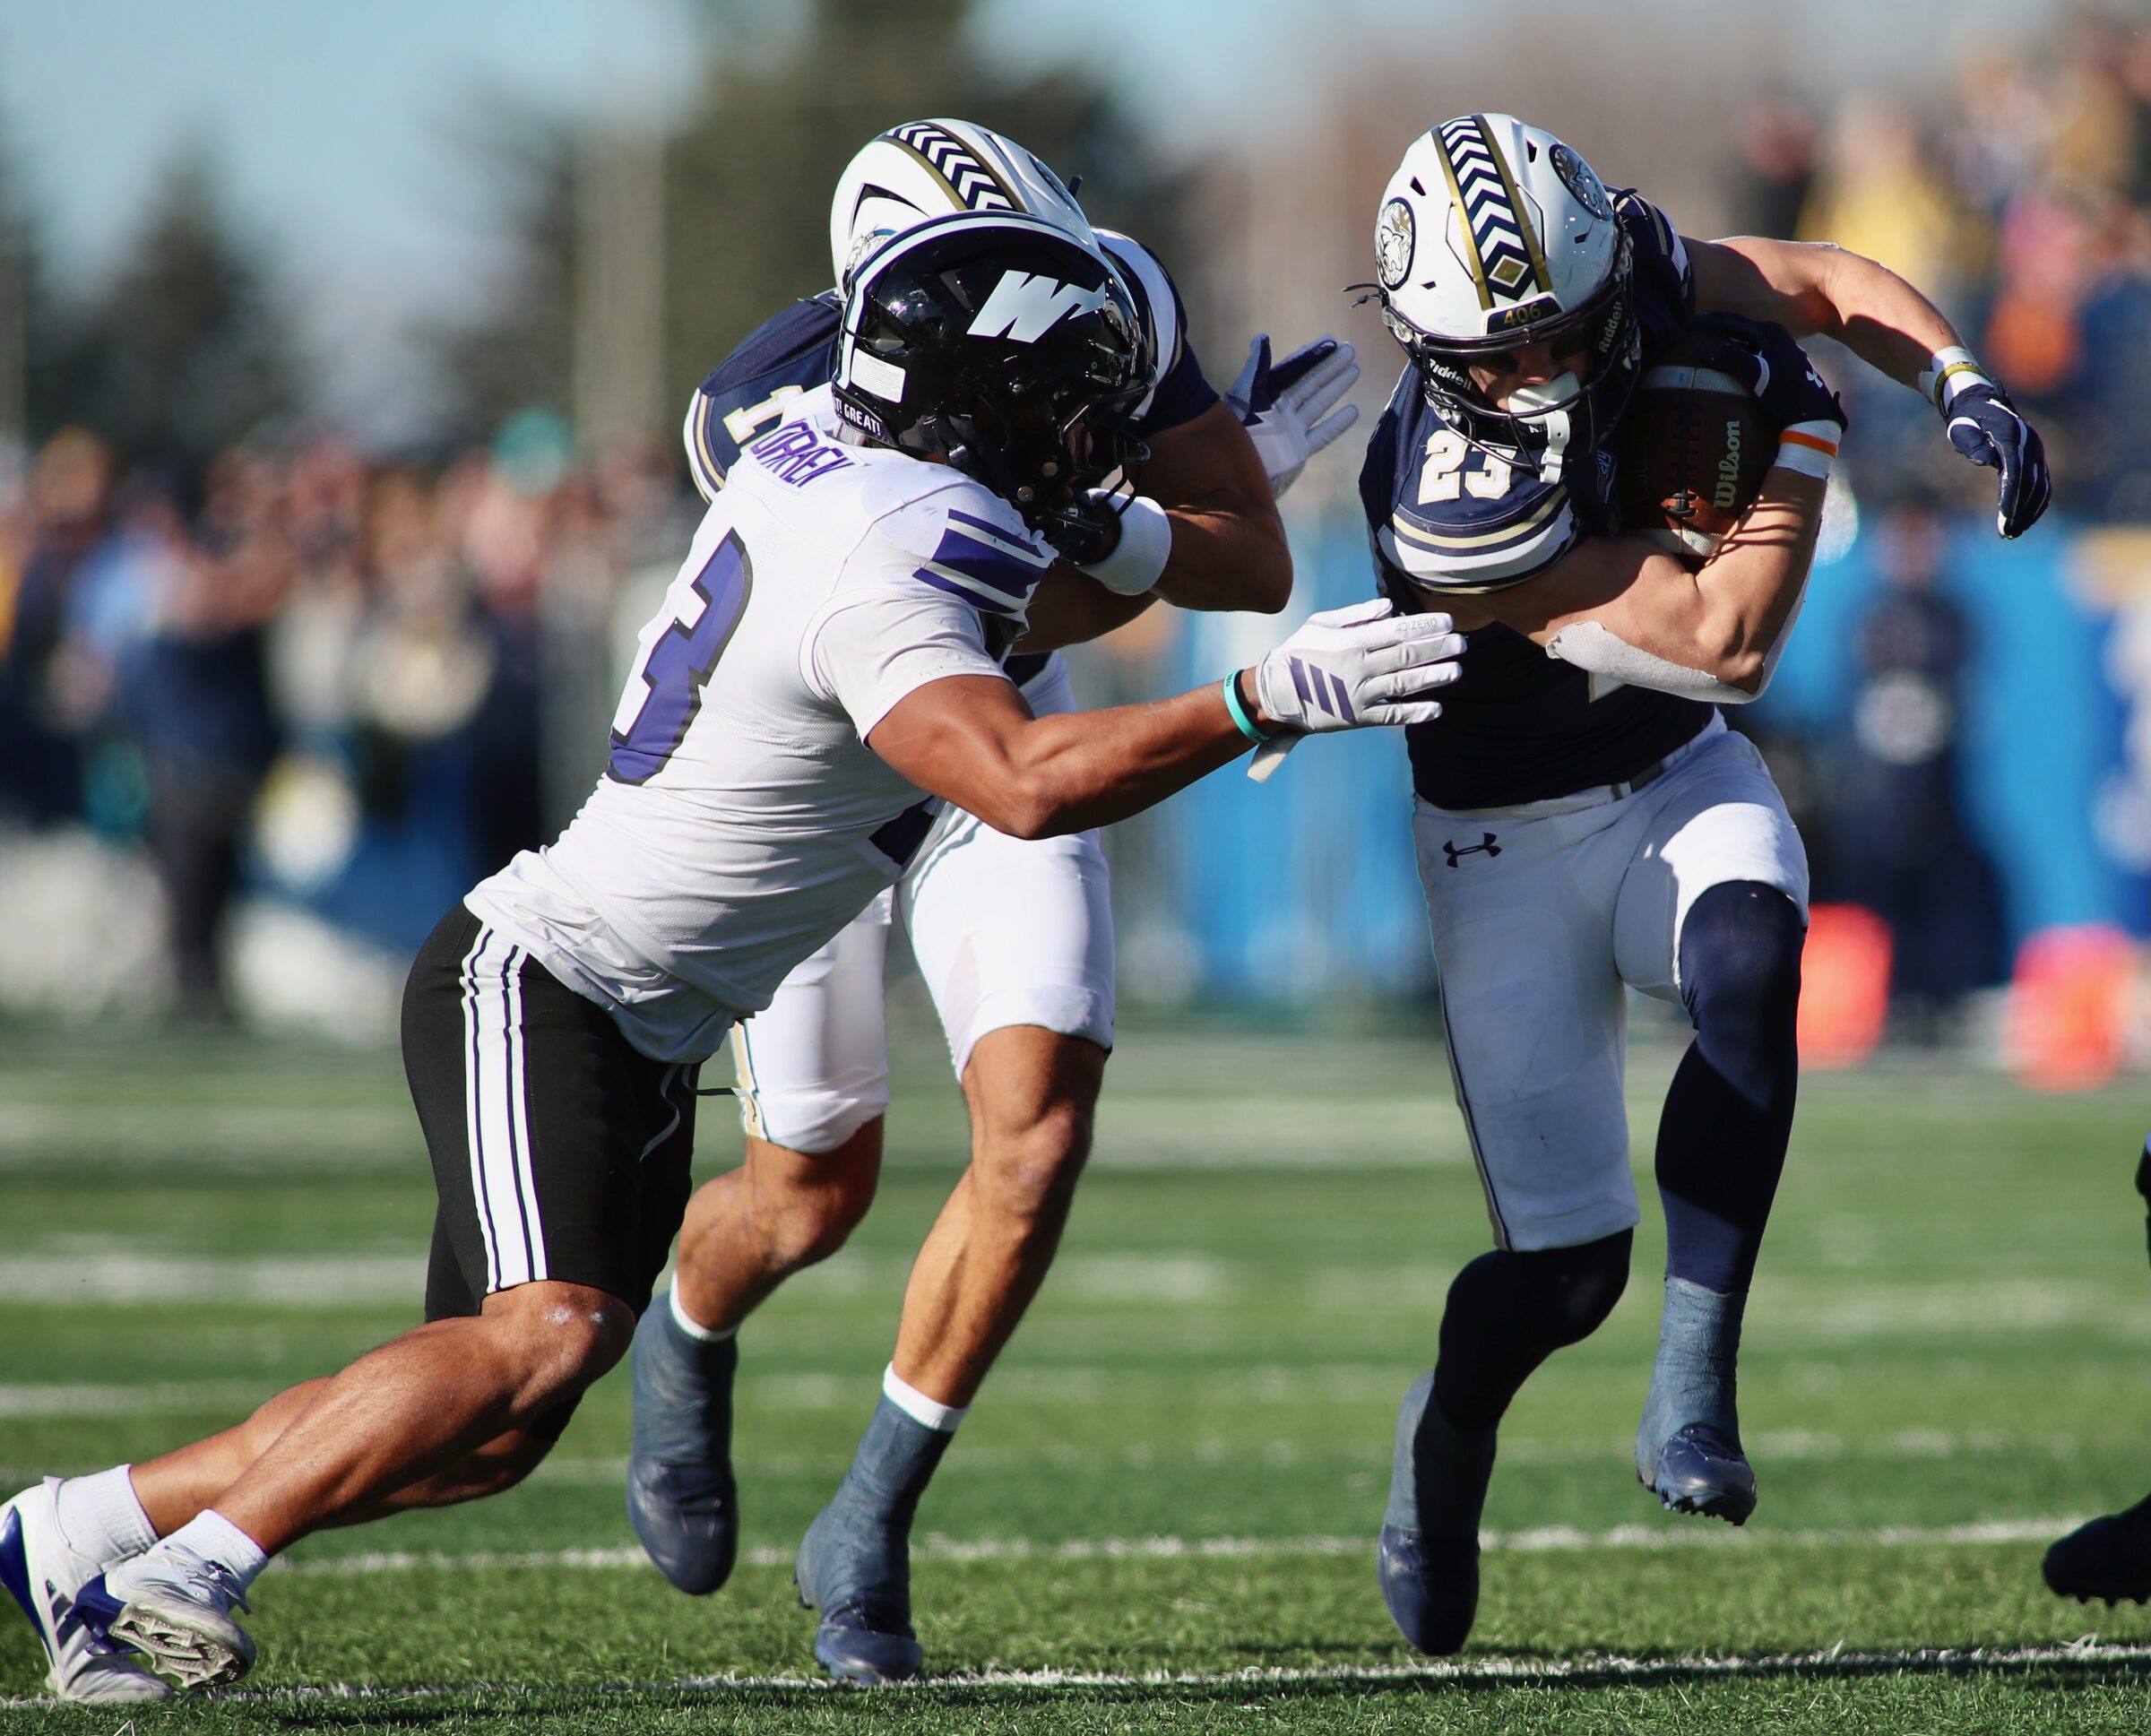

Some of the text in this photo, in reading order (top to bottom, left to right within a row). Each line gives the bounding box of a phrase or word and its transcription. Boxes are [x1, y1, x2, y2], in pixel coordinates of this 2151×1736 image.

[1504, 302, 1542, 325] 406
[1598, 301, 1623, 354] Riddell
[844, 402, 882, 436] GREAT!
[1418, 429, 1517, 505] 23
[1714, 419, 1741, 508] Wilson
[1395, 618, 1438, 633] ADIZERO
